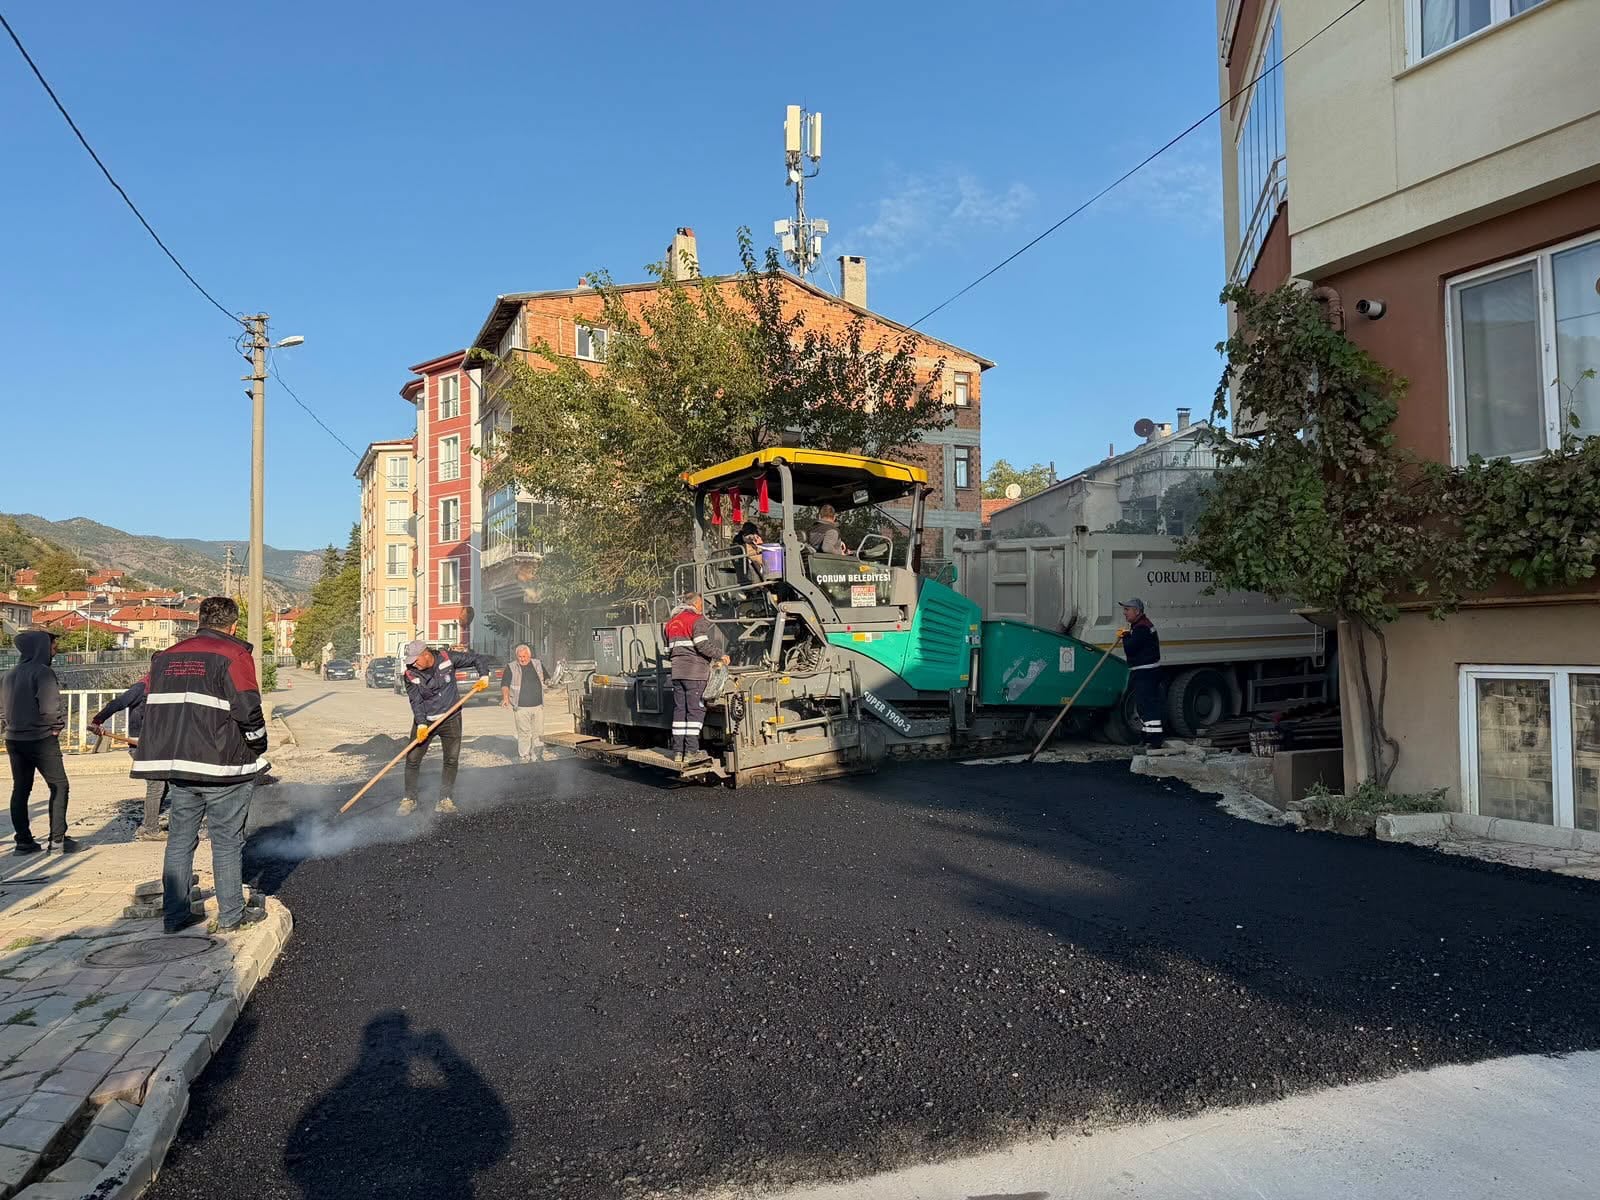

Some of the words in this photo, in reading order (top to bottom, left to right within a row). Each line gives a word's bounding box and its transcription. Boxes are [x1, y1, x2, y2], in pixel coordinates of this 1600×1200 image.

[816, 574, 846, 585] ÇORUM
[848, 572, 891, 582] BELEDİYESİ
[1147, 570, 1190, 586] ÇORUM
[885, 709, 911, 732] 1900-3
